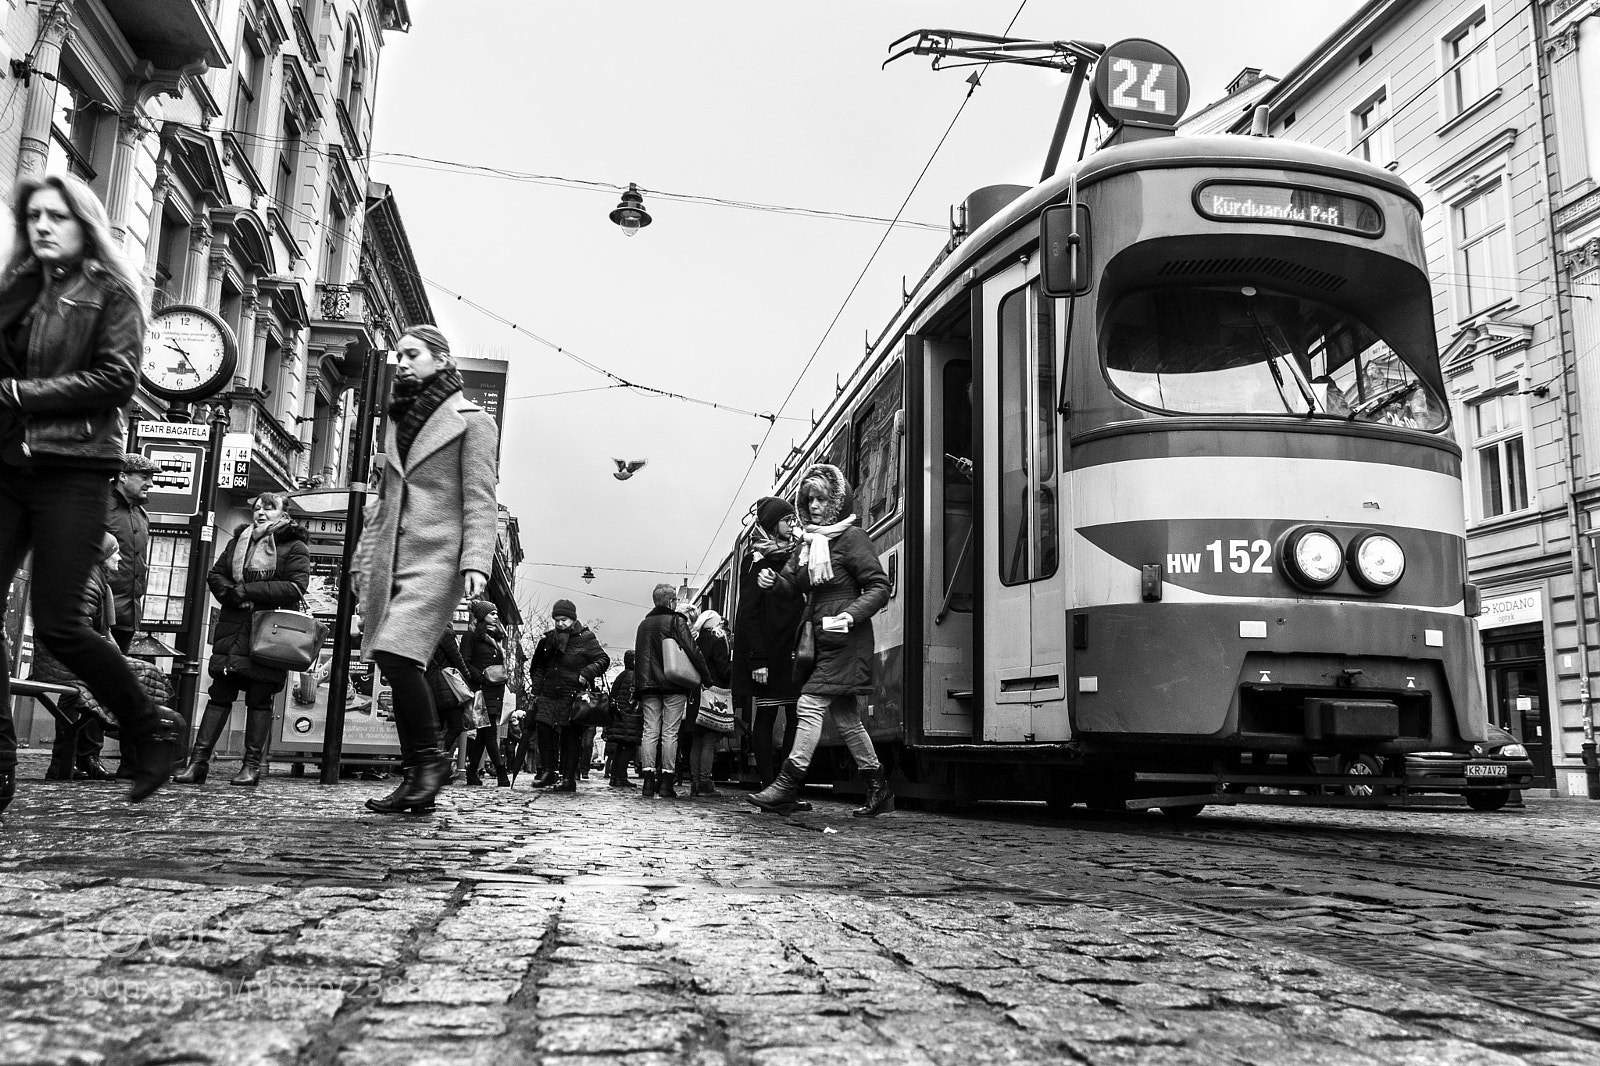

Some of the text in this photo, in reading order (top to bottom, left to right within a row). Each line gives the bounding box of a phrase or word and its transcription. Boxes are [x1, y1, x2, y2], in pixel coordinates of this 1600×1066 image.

[1113, 59, 1165, 111] 24
[1311, 205, 1338, 226] P+R
[165, 321, 171, 329] 11
[180, 317, 190, 326] 12
[151, 331, 160, 340] 10
[210, 333, 217, 343] 2
[144, 346, 151, 354] 9
[213, 348, 220, 358] 3
[148, 361, 155, 370] 8
[176, 378, 183, 387] 6
[141, 424, 207, 437] TEATR BAGATELA
[226, 449, 231, 458] 4
[238, 450, 247, 459] 44
[223, 461, 231, 472] 14
[236, 461, 246, 473] 64
[221, 476, 230, 486] 24
[234, 477, 247, 487] 664
[305, 520, 310, 530] 4
[321, 521, 326, 531] 8
[335, 522, 343, 532] 13
[1166, 539, 1273, 574] HW 152
[1492, 597, 1535, 614] KODANO
[1468, 767, 1507, 775] KR 7AV22
